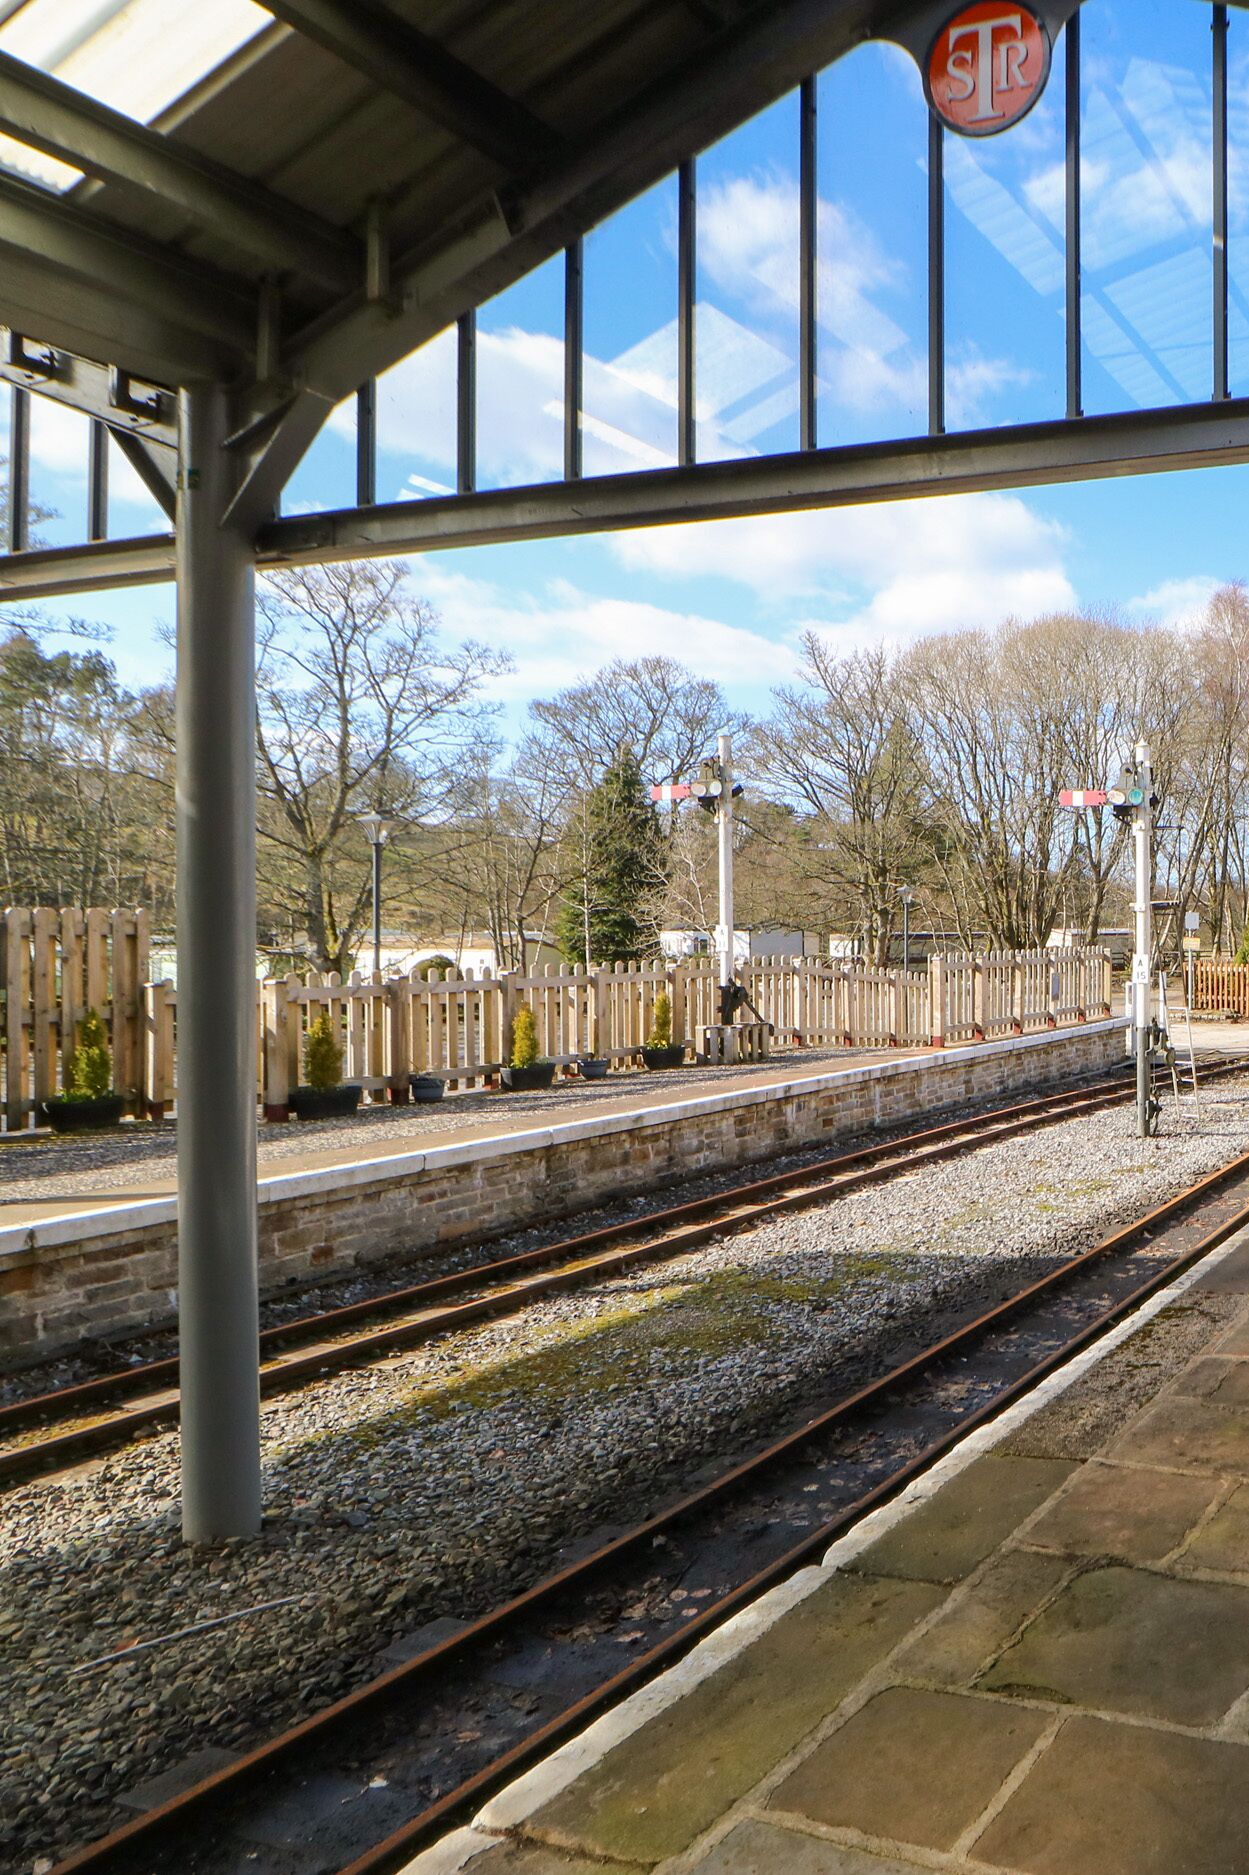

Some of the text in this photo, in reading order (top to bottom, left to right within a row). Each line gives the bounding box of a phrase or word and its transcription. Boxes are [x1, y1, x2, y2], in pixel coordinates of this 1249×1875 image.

[946, 14, 1032, 124] STR
[1137, 959, 1143, 967] A
[1136, 971, 1146, 979] 15
